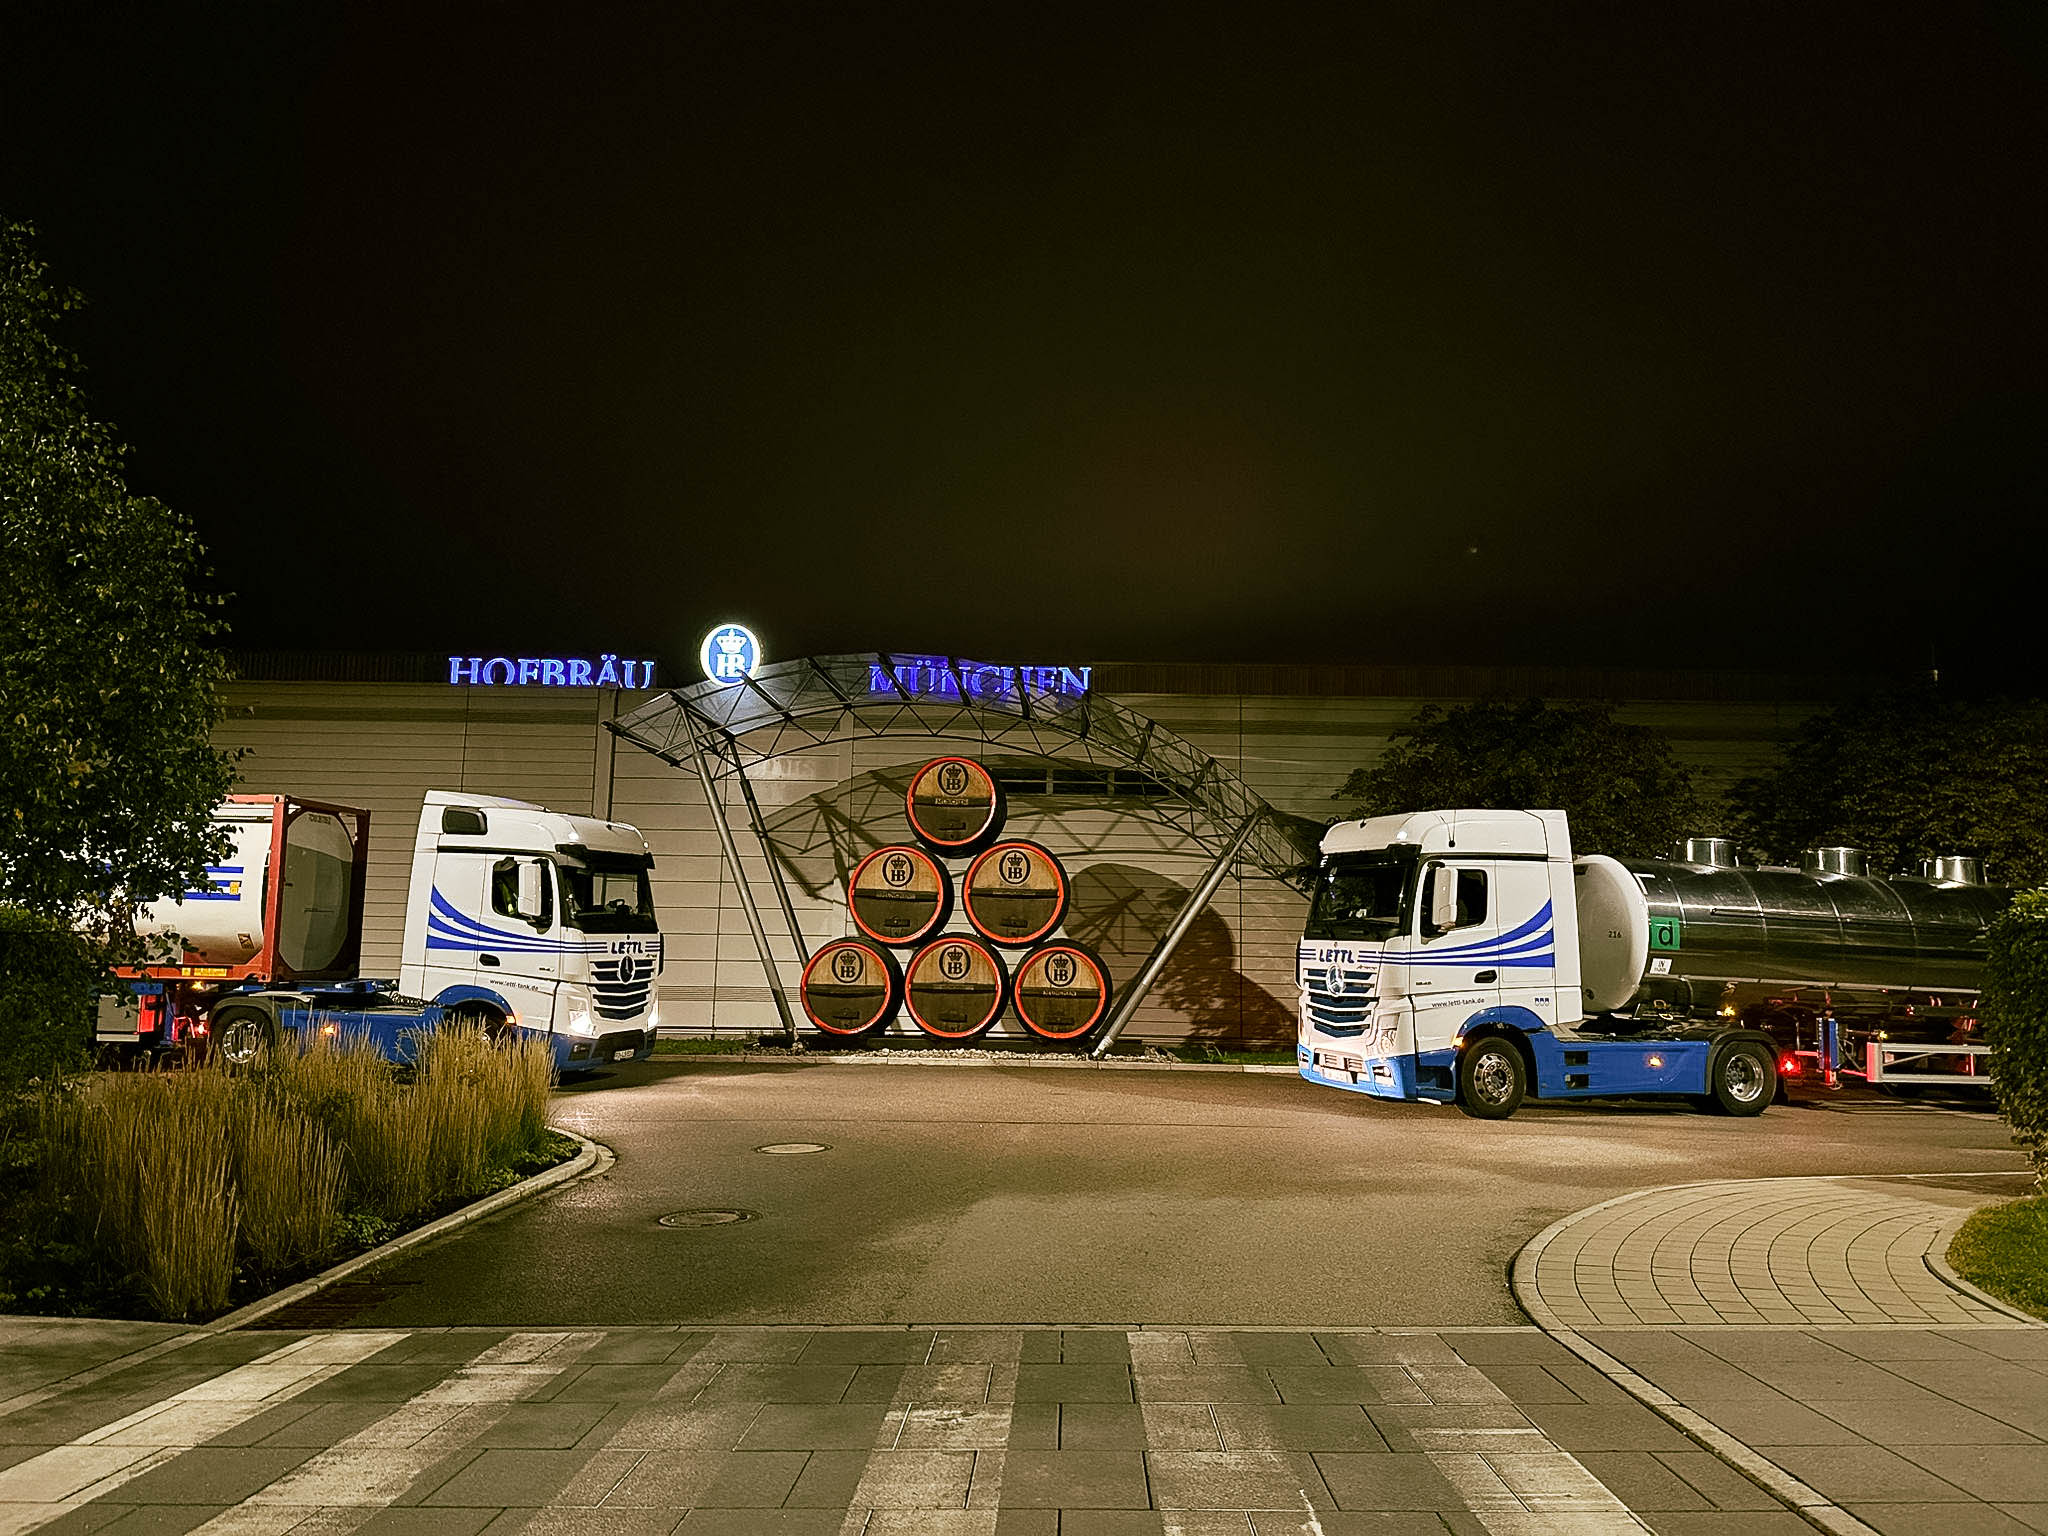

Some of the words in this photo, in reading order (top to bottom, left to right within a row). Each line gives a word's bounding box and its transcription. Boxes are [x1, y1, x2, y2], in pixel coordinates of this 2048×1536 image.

[449, 654, 655, 689] HOFBRÄU
[869, 659, 1092, 694] MÜNCHEN
[946, 778, 961, 790] HB
[890, 869, 906, 881] HB
[1007, 866, 1023, 879] HB
[1658, 921, 1673, 946] d
[611, 941, 643, 954] LETTL
[1319, 949, 1355, 964] LETTL
[840, 965, 856, 978] HB
[947, 961, 963, 974] HB
[1053, 968, 1069, 981] HB
